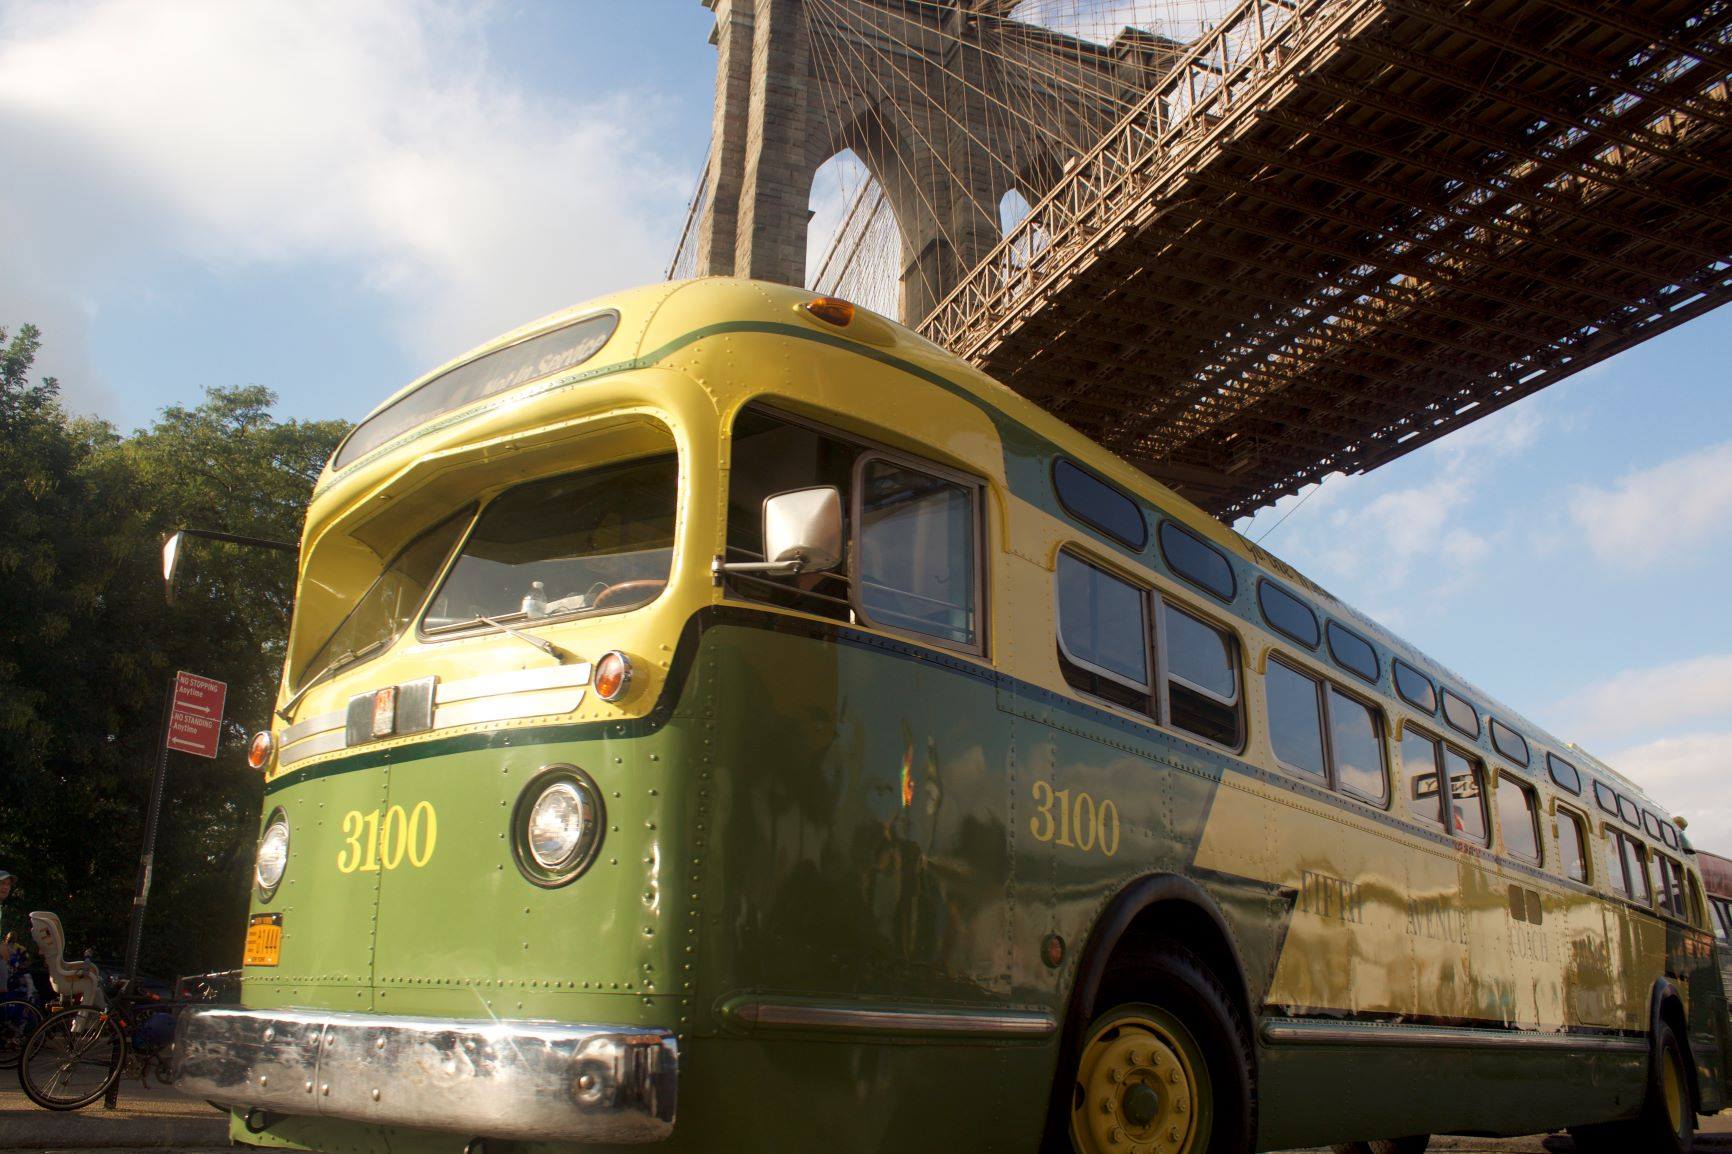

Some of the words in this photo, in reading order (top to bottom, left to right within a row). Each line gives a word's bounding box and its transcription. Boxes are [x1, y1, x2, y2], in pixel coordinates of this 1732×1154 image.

[179, 686, 204, 697] Anytime
[180, 677, 190, 685] NO
[190, 679, 218, 693] STOPPING
[173, 722, 198, 734] Anytime
[174, 713, 184, 721] NO
[184, 715, 213, 728] STANDING
[1030, 780, 1120, 857] 3100
[337, 800, 438, 874] 3100
[1301, 869, 1363, 925] FIFTH
